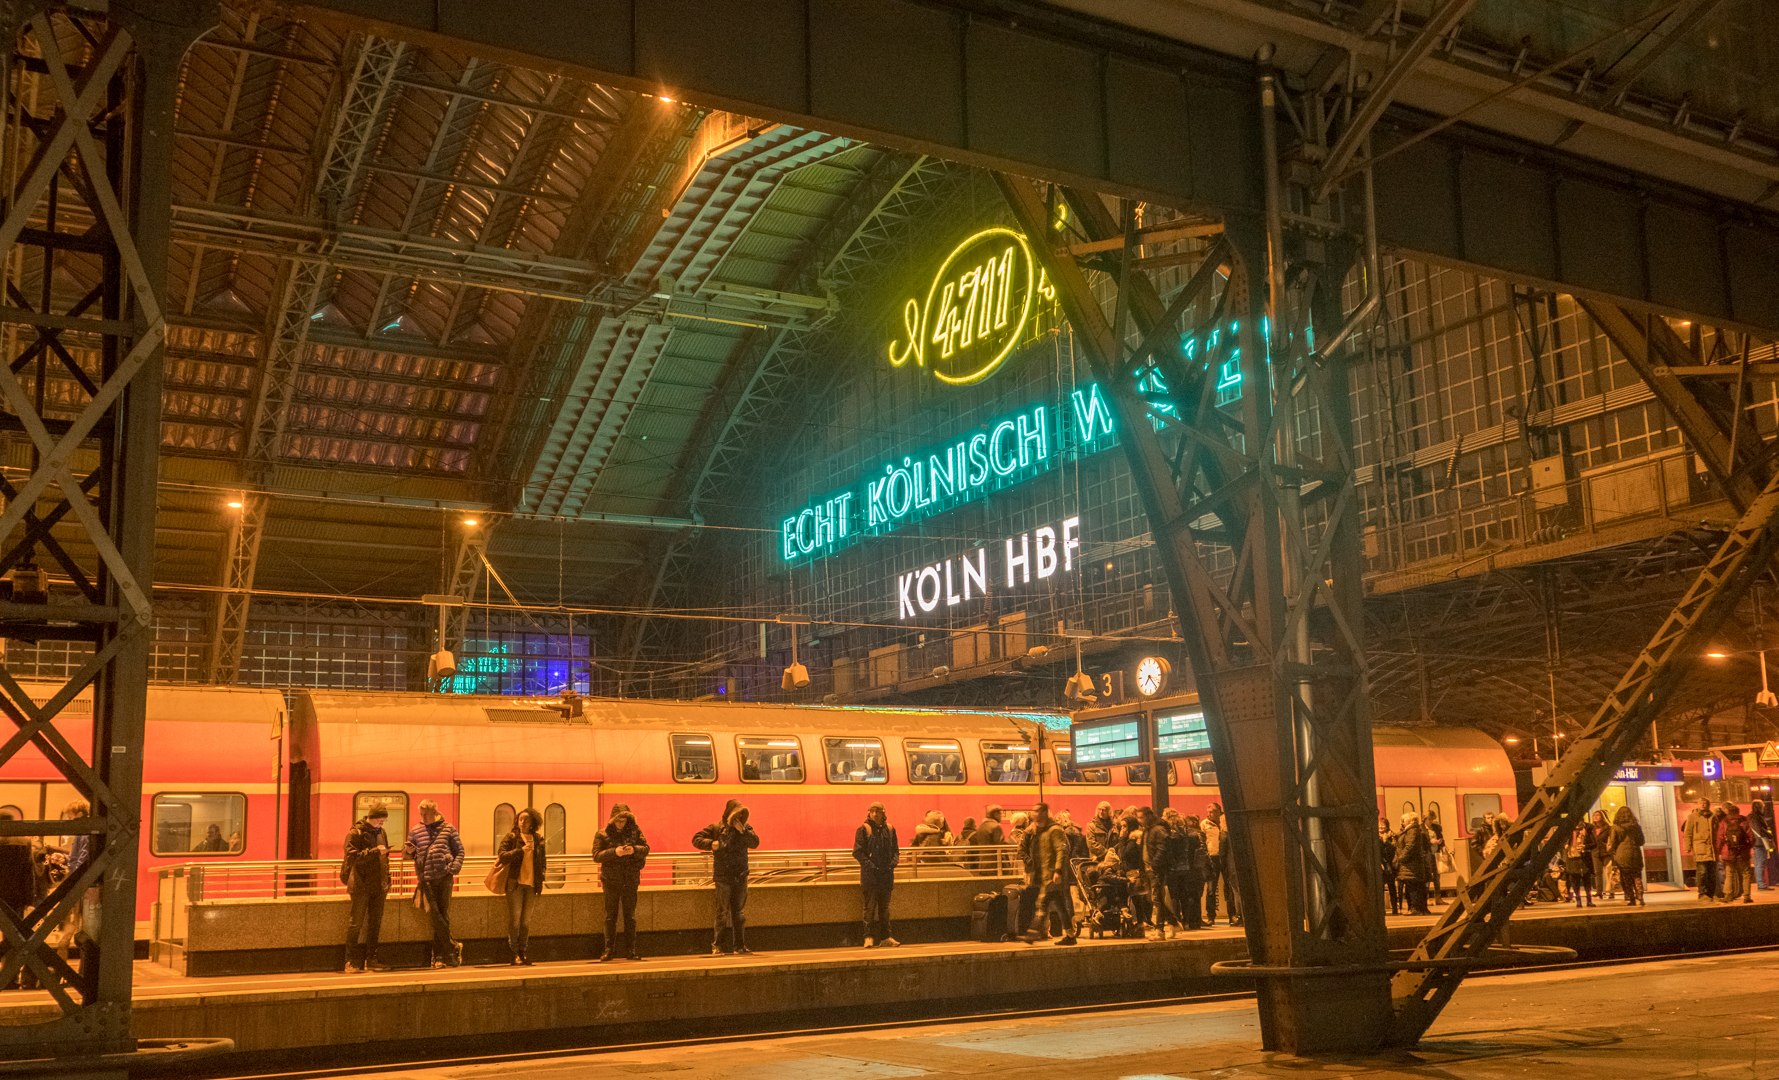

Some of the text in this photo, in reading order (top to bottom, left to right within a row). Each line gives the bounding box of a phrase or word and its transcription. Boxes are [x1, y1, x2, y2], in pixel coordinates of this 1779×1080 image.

[932, 245, 1015, 360] 4711
[783, 405, 1050, 561] ECHT KÖLNISCH
[899, 516, 1081, 620] KÖLN HBF
[1102, 673, 1113, 697] 3
[1703, 759, 1716, 776] B
